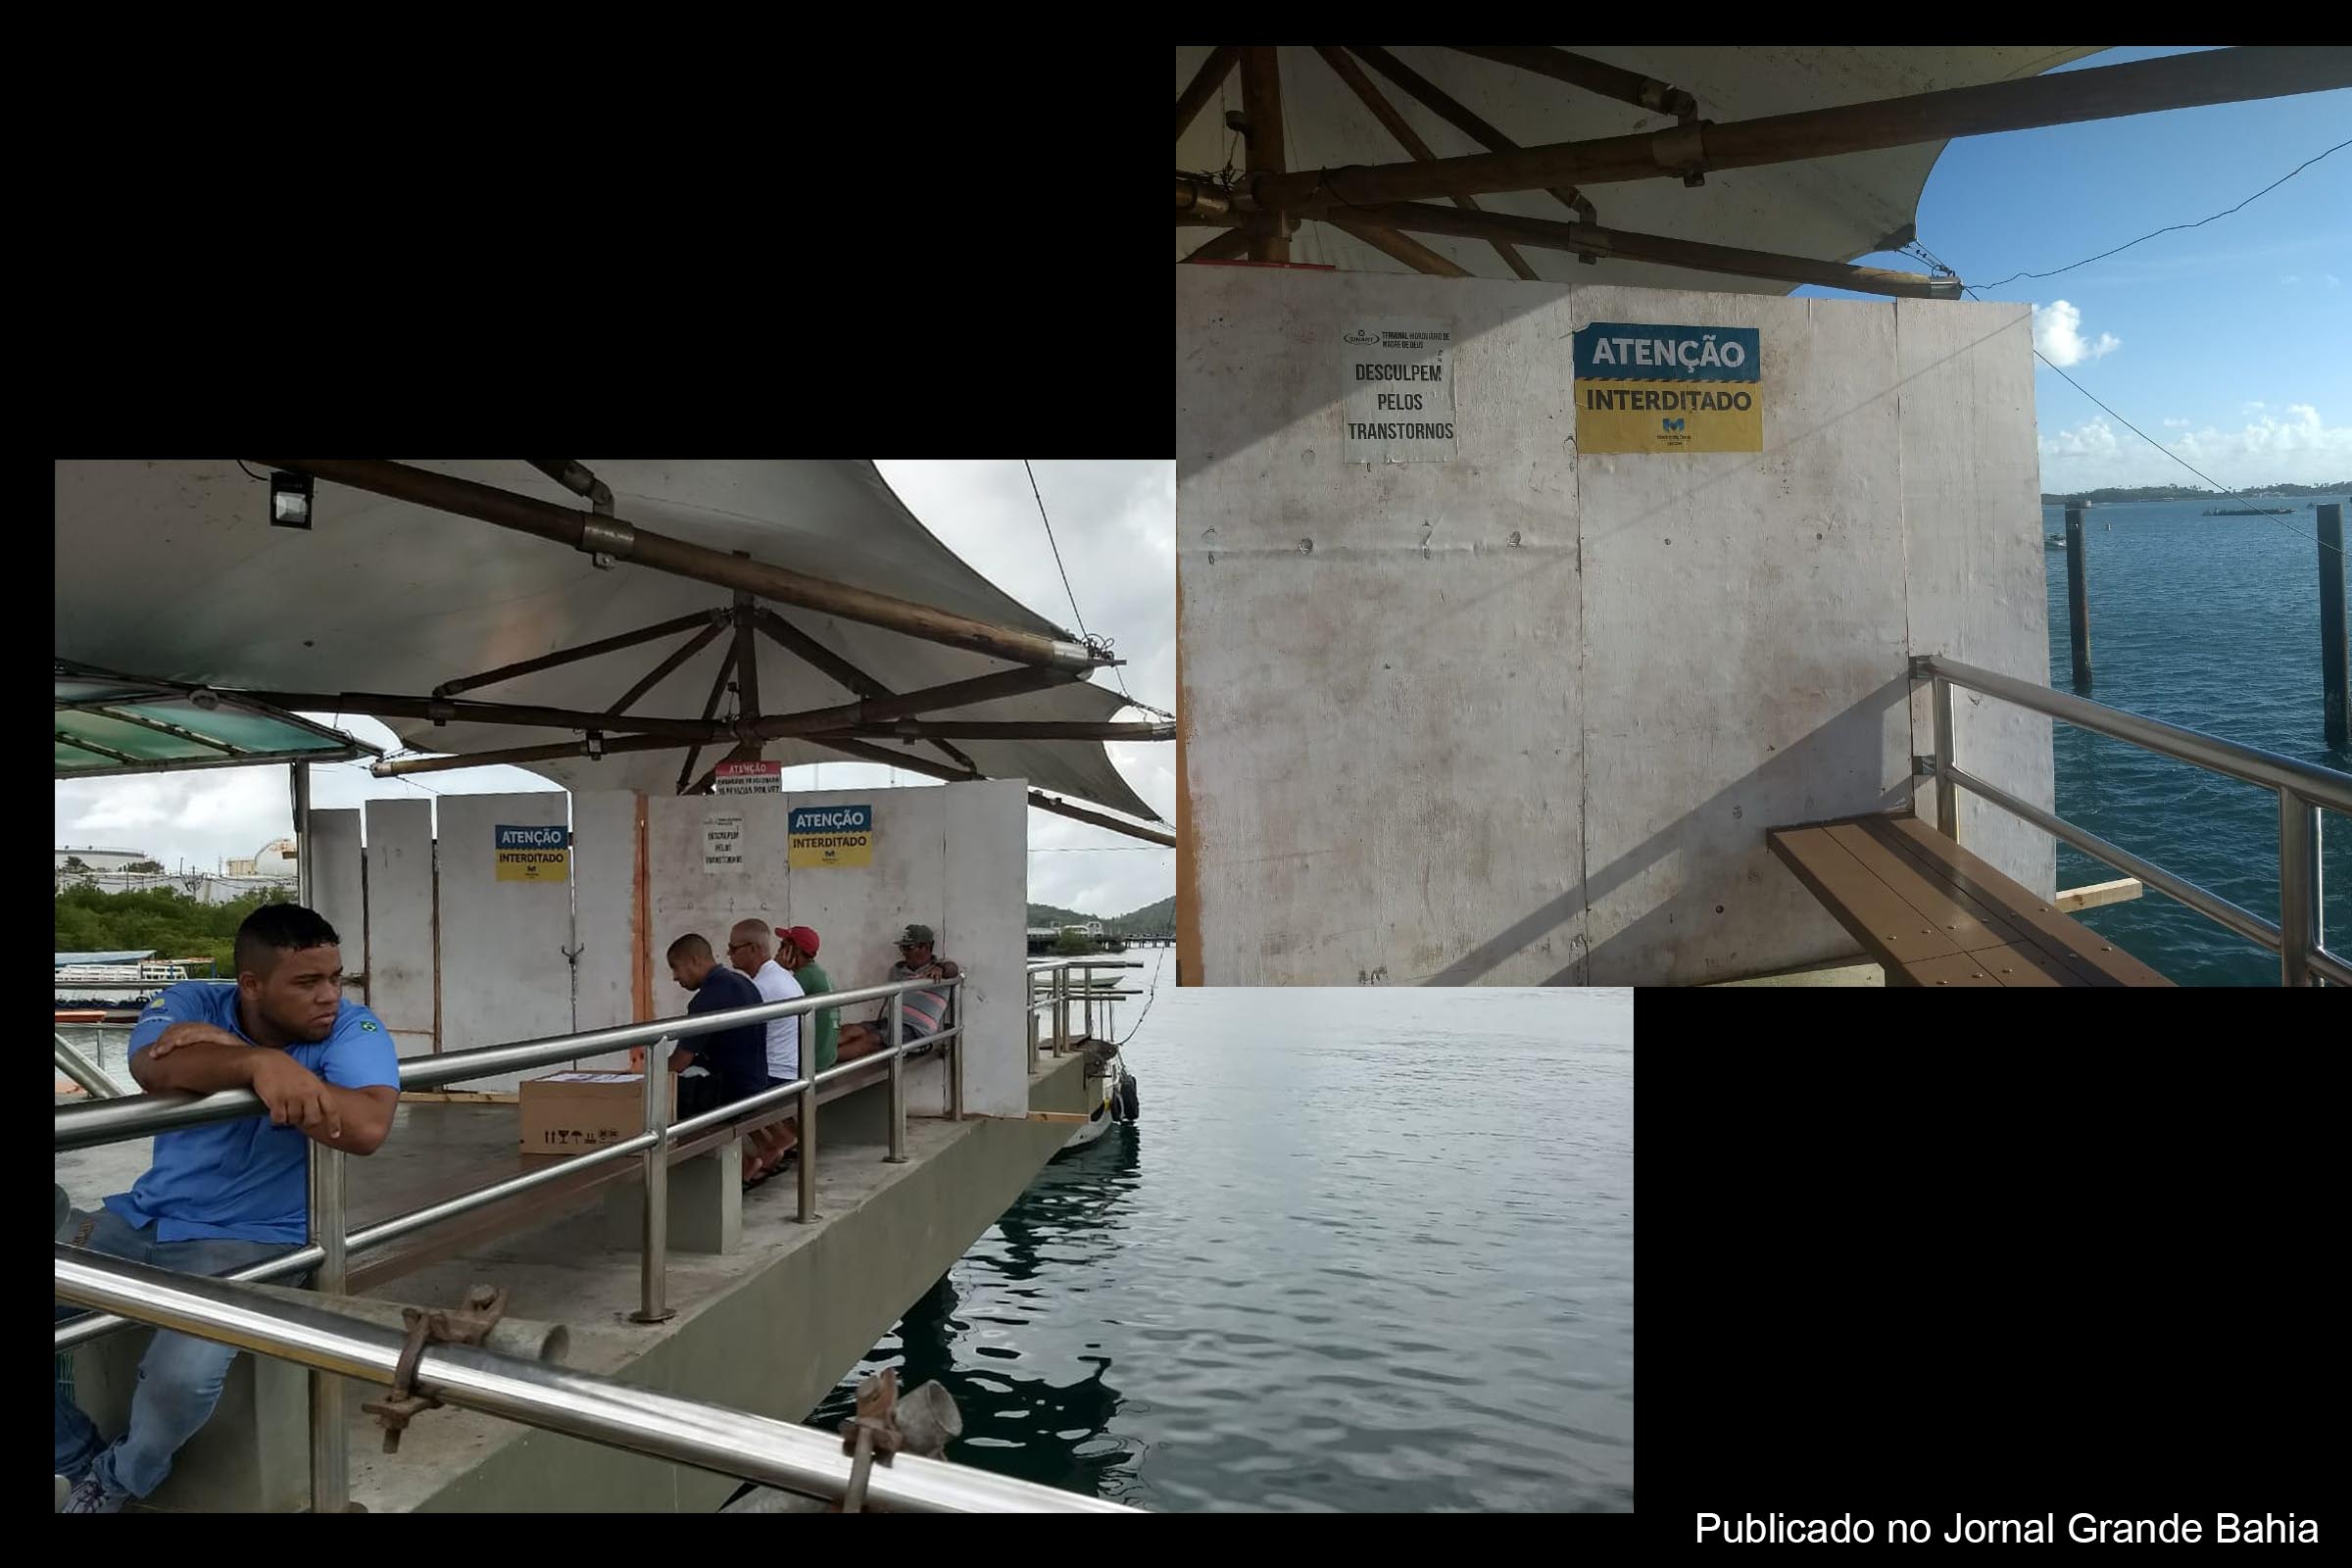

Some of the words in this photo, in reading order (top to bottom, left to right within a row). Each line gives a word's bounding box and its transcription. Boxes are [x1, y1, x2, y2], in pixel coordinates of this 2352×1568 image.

[1592, 334, 1745, 373] ATENÇÃO
[1355, 364, 1442, 381] DESCULPEM
[1378, 393, 1423, 411] PELOS
[1587, 389, 1752, 412] INTERDITADO
[1348, 422, 1454, 439] TRANSTORNOS
[796, 808, 864, 829] ATENÇÃO
[502, 828, 562, 847] ATENÇÃO
[793, 836, 867, 849] INTERDITADO
[499, 853, 564, 863] INTERDITADO
